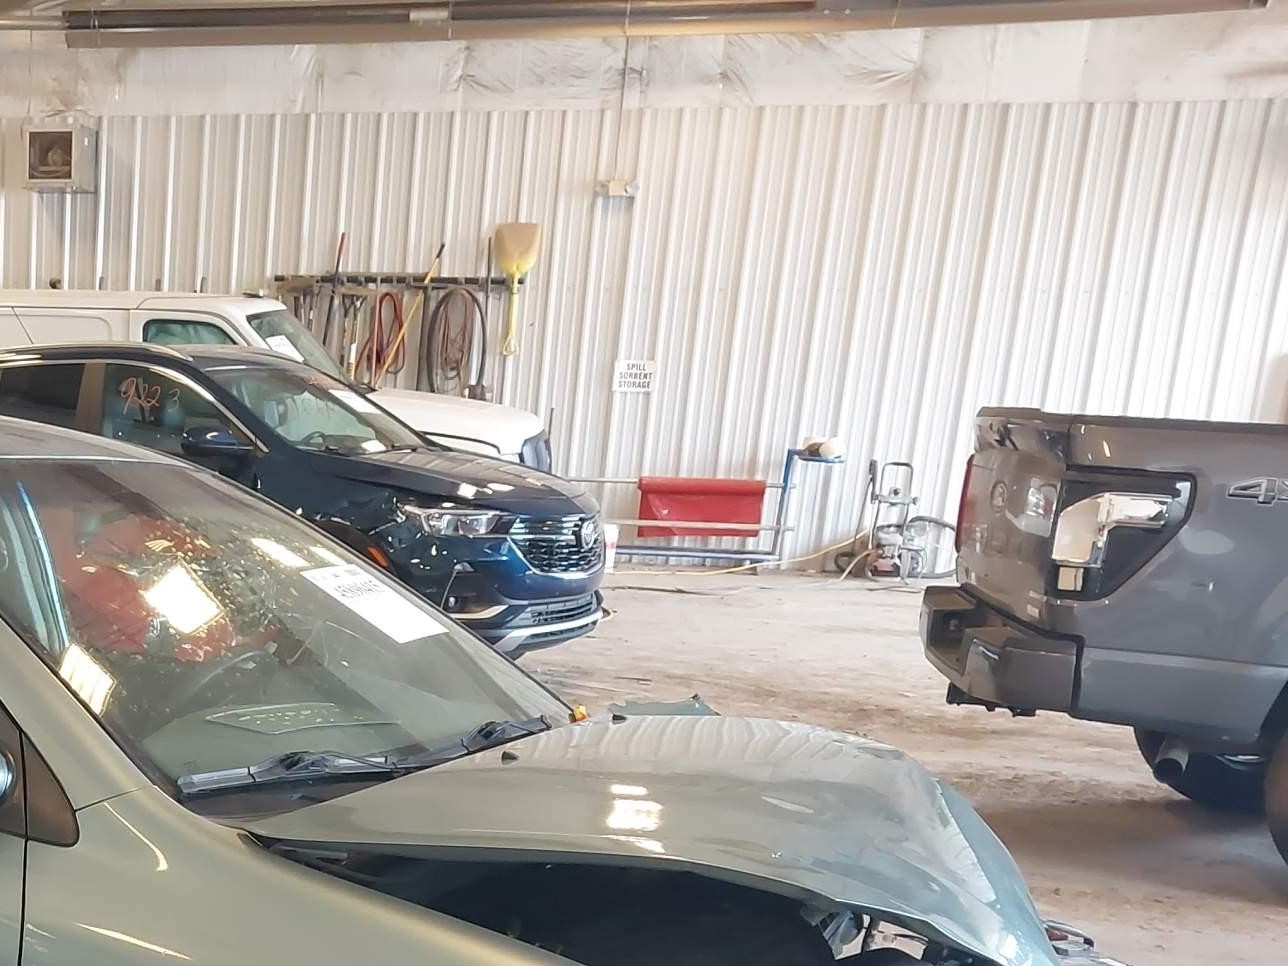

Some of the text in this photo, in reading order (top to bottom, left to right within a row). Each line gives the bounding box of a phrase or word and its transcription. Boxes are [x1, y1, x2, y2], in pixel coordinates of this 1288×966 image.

[626, 363, 647, 371] SPILL
[618, 371, 653, 380] SORBENT
[617, 380, 651, 389] STORAGE
